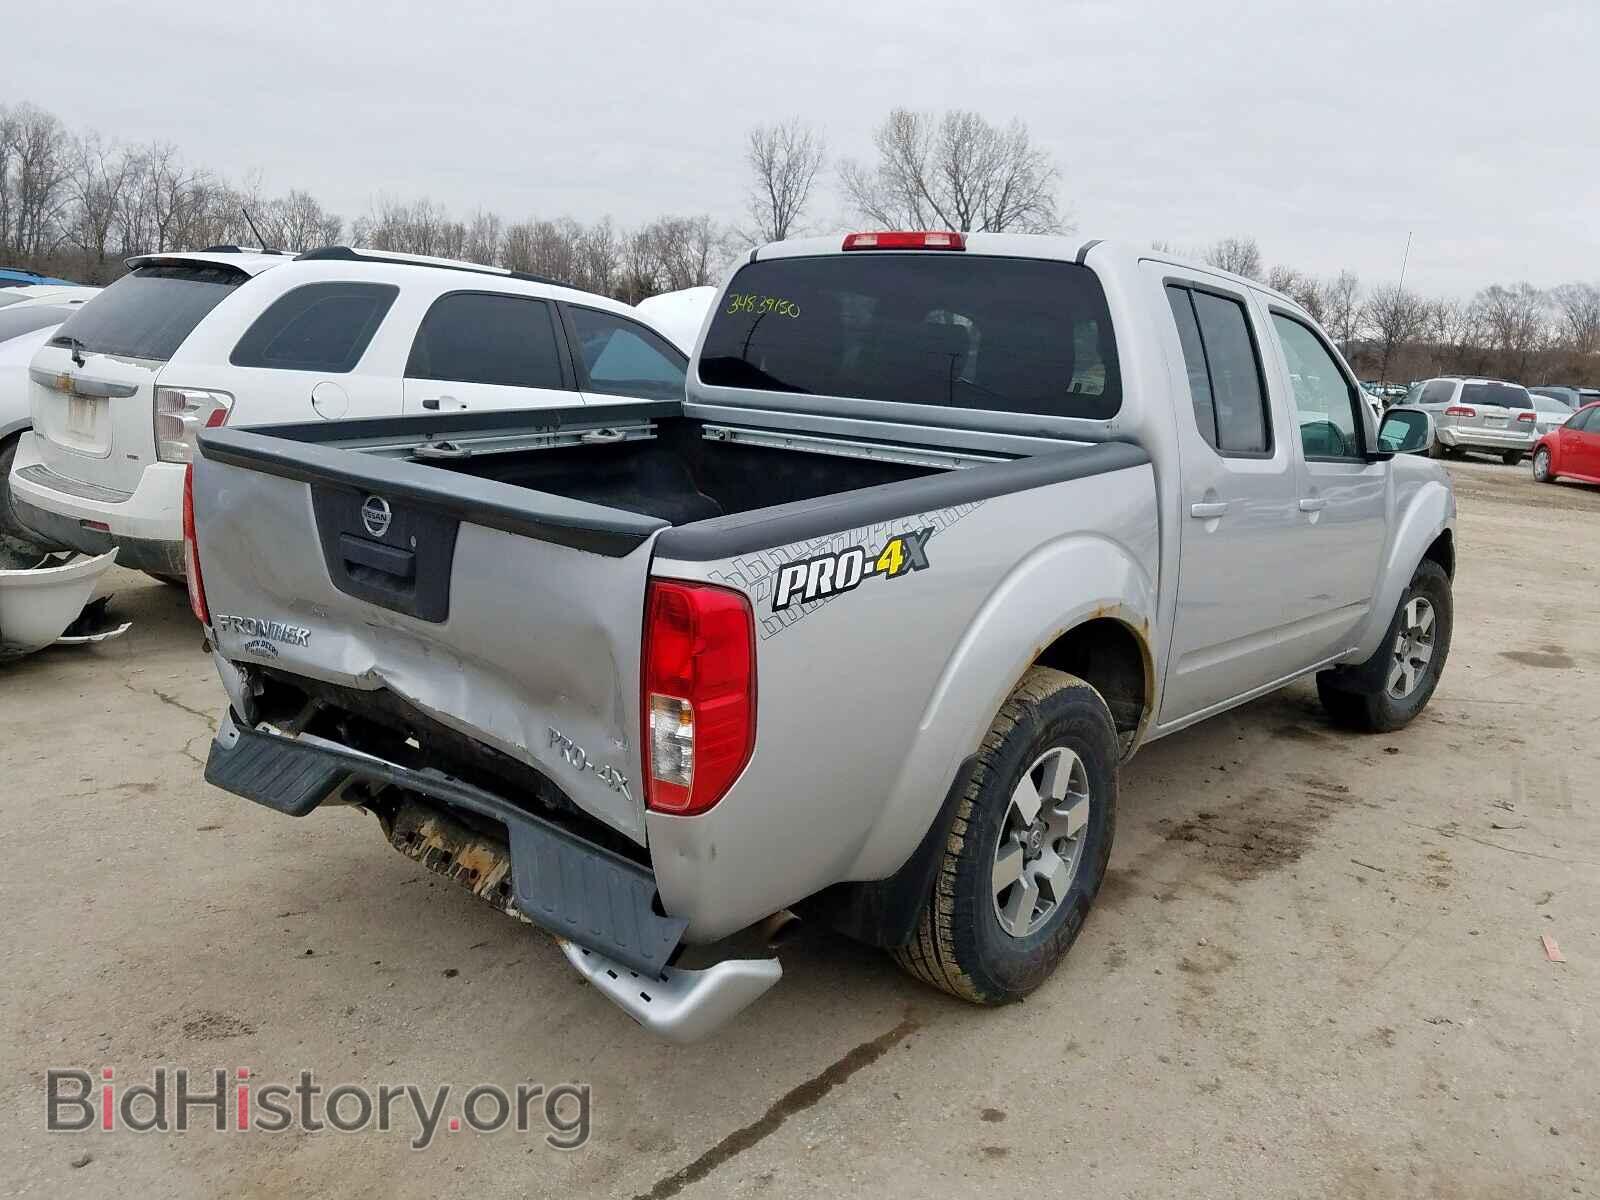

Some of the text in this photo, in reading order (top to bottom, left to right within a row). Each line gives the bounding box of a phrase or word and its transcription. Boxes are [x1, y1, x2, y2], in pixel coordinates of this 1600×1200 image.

[772, 525, 934, 612] PRO-4X
[216, 614, 311, 647] FRONTIER
[548, 727, 632, 800] PRO-4X
